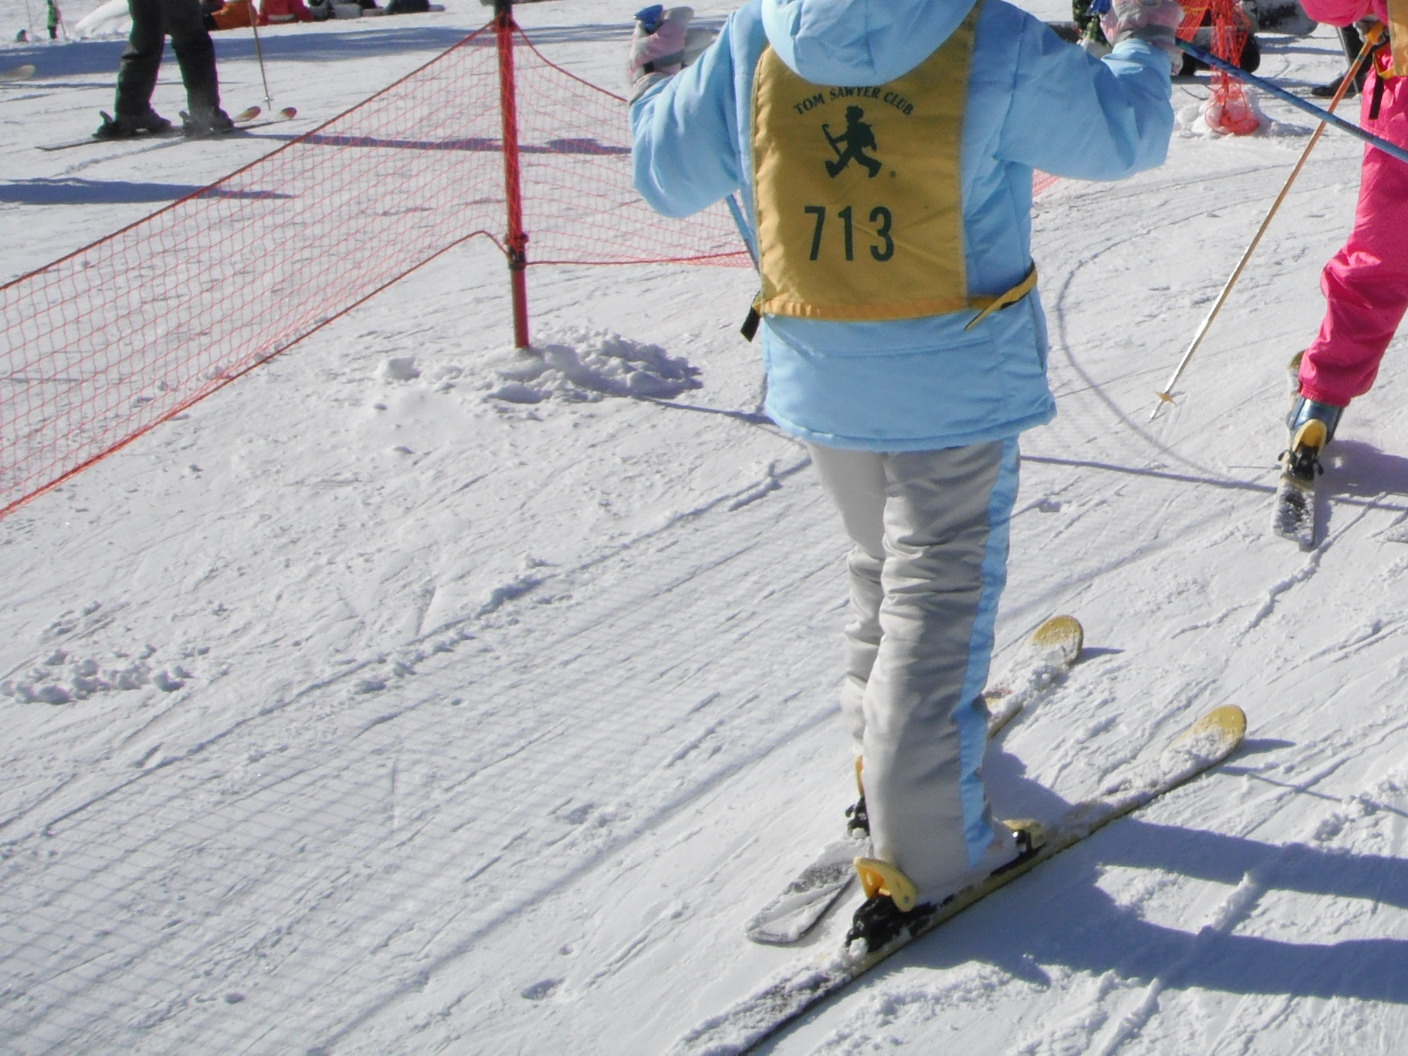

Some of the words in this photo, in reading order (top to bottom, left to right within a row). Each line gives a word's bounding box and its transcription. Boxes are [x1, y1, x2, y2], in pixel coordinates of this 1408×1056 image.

[793, 92, 826, 115] TOM
[829, 85, 881, 101] SAWYER
[883, 90, 914, 116] CLUB
[803, 205, 895, 262] 713
